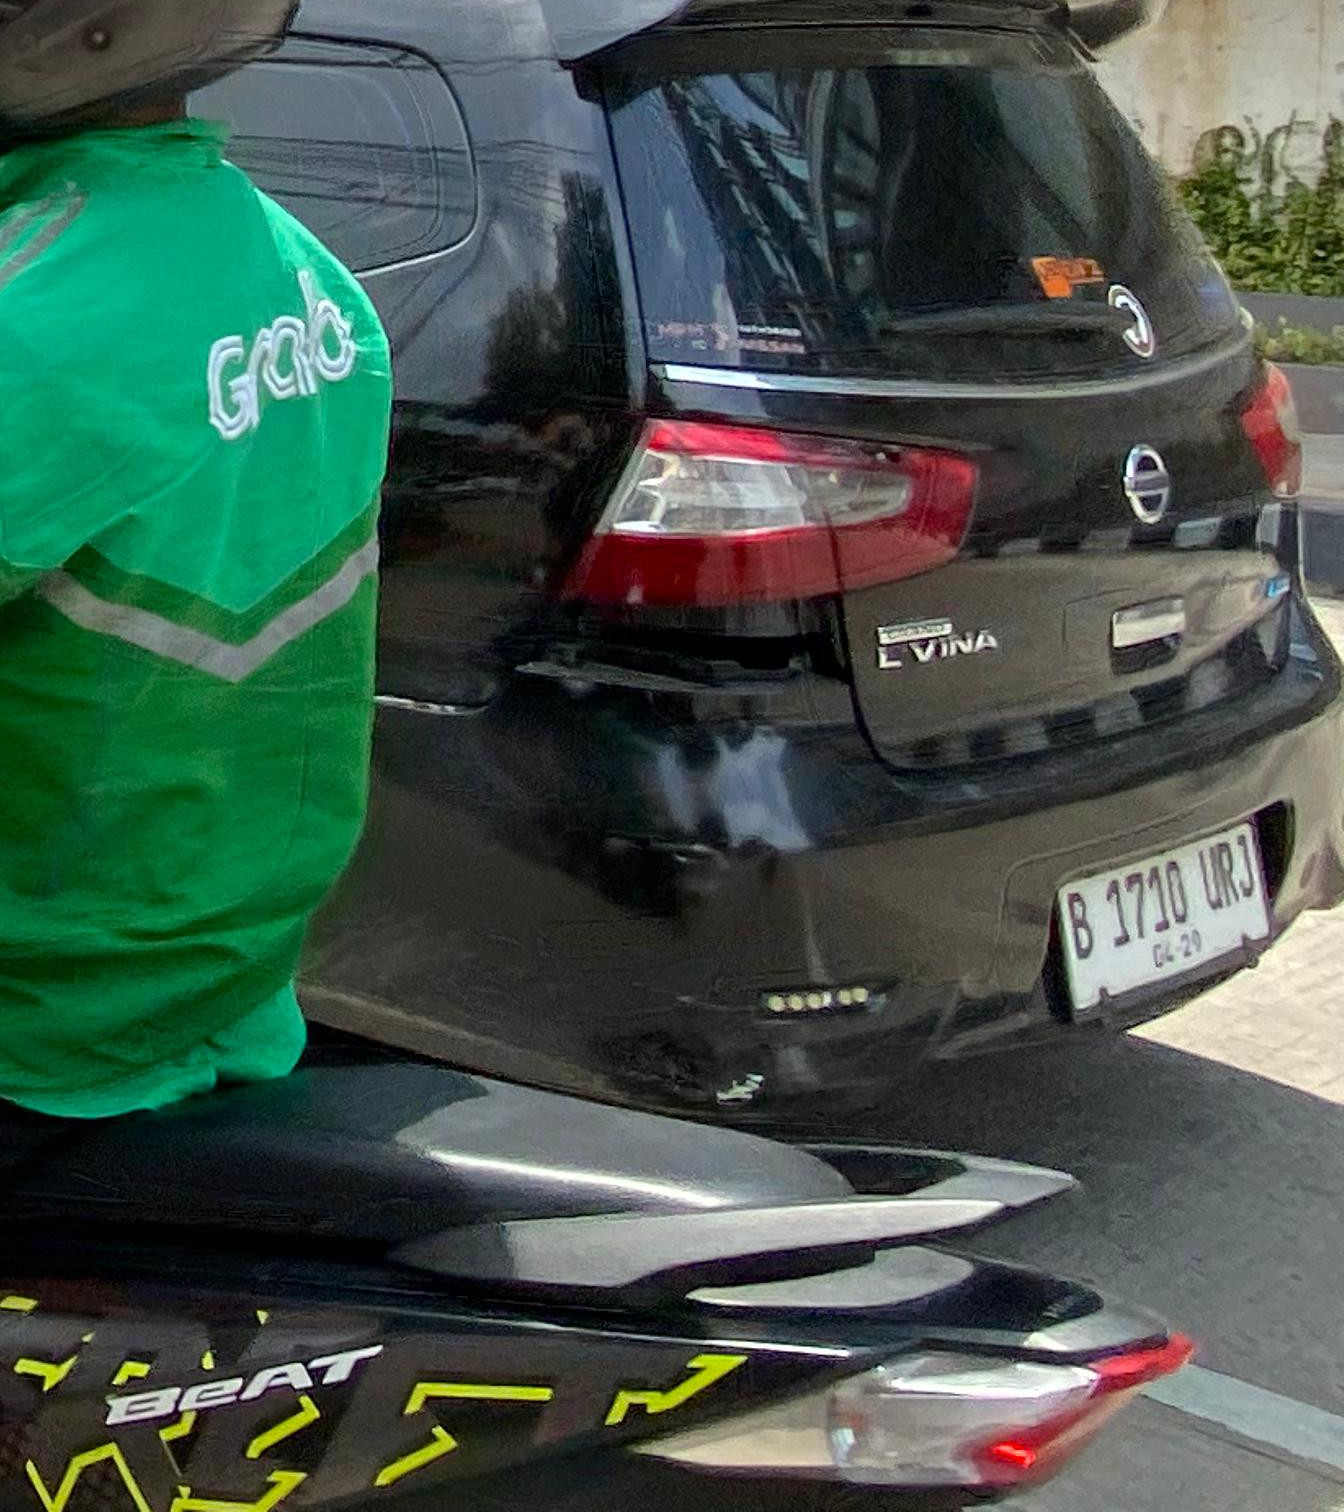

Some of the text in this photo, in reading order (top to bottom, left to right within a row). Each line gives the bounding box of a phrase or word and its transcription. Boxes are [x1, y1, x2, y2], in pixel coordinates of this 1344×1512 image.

[207, 269, 356, 440] Grab
[1067, 834, 1255, 960] B 1710 URJ
